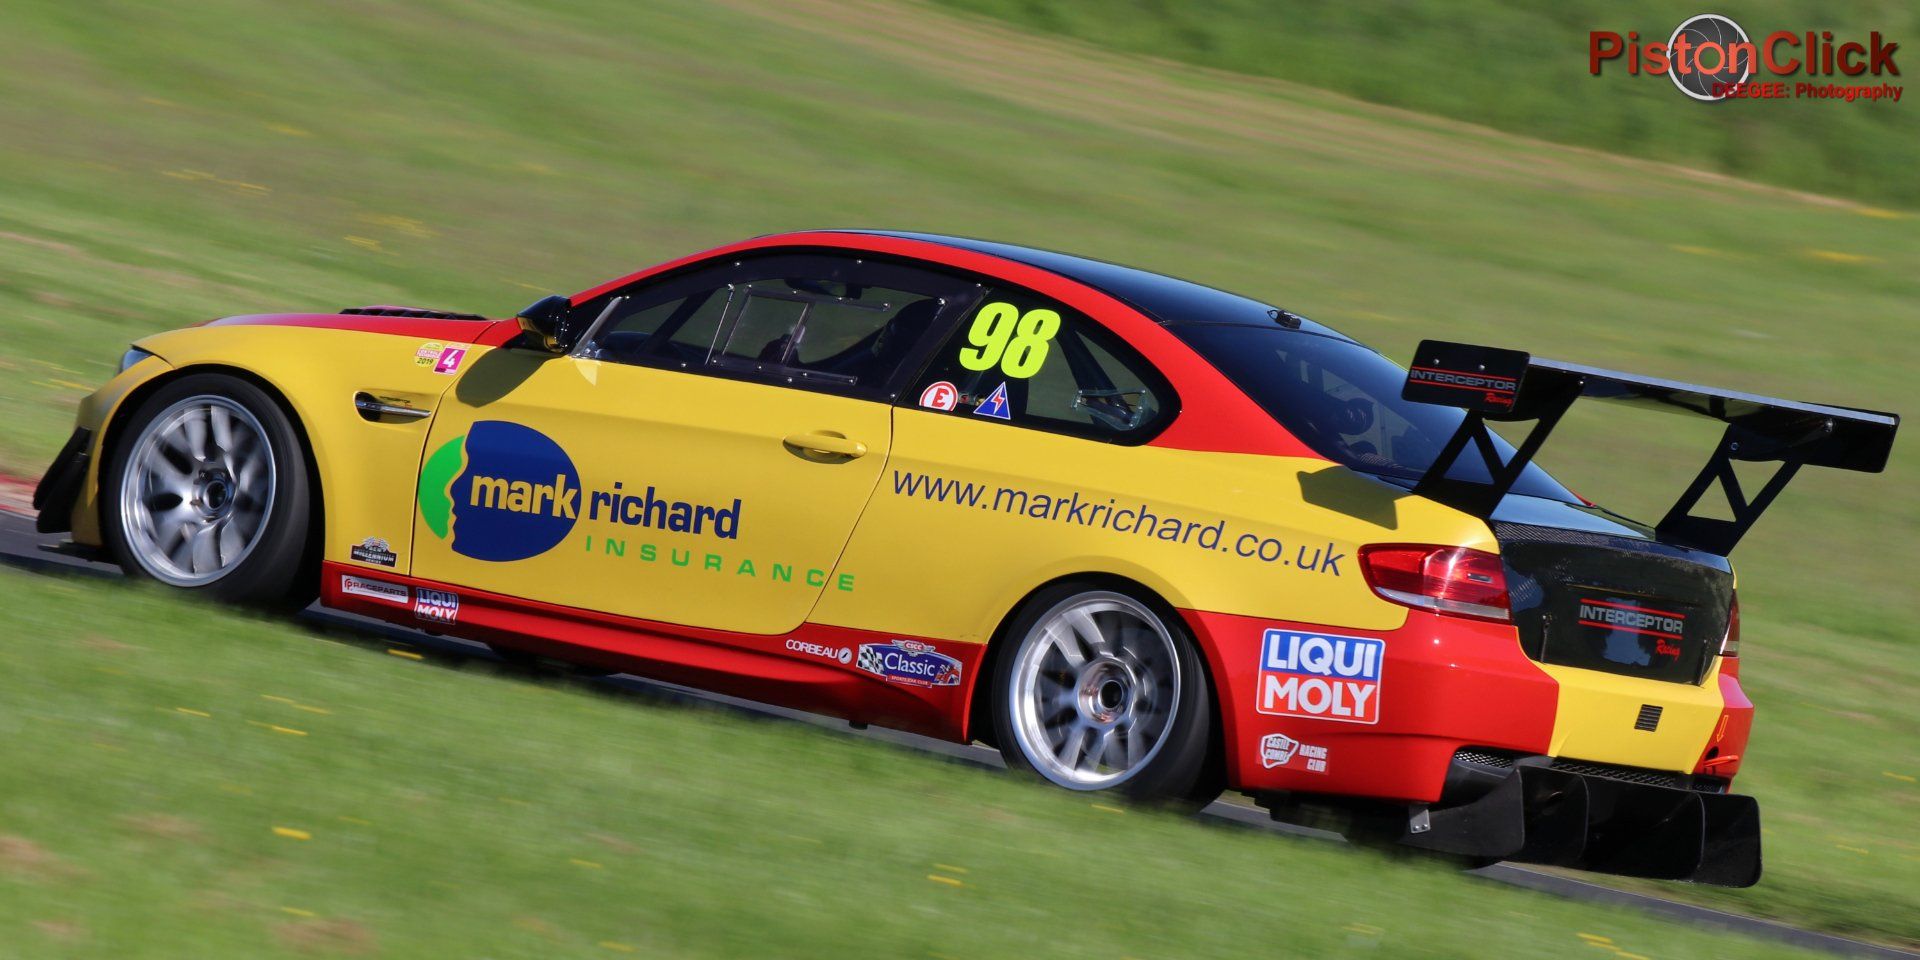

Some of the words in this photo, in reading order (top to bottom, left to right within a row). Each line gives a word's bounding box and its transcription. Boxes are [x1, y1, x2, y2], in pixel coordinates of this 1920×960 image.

[959, 302, 1061, 379] 98
[417, 357, 434, 365] 2019
[442, 349, 459, 367] 4
[1410, 369, 1516, 391] INTERCEPTOR
[931, 388, 949, 408] E
[470, 474, 577, 520] mark
[589, 482, 742, 540] richard
[893, 469, 1346, 577] www.markrichard.co.uk
[585, 535, 856, 593] INSURANCE
[353, 582, 406, 596] RACEPARTS
[418, 590, 456, 607] LIQUI
[417, 604, 455, 619] MOLY
[1579, 604, 1683, 634] INTERCEPTOR
[786, 639, 838, 659] CORBEAU
[1267, 634, 1377, 678] LIQUI
[1656, 639, 1681, 662] Racing
[884, 652, 936, 677] Classic
[1264, 675, 1377, 718] MOLY
